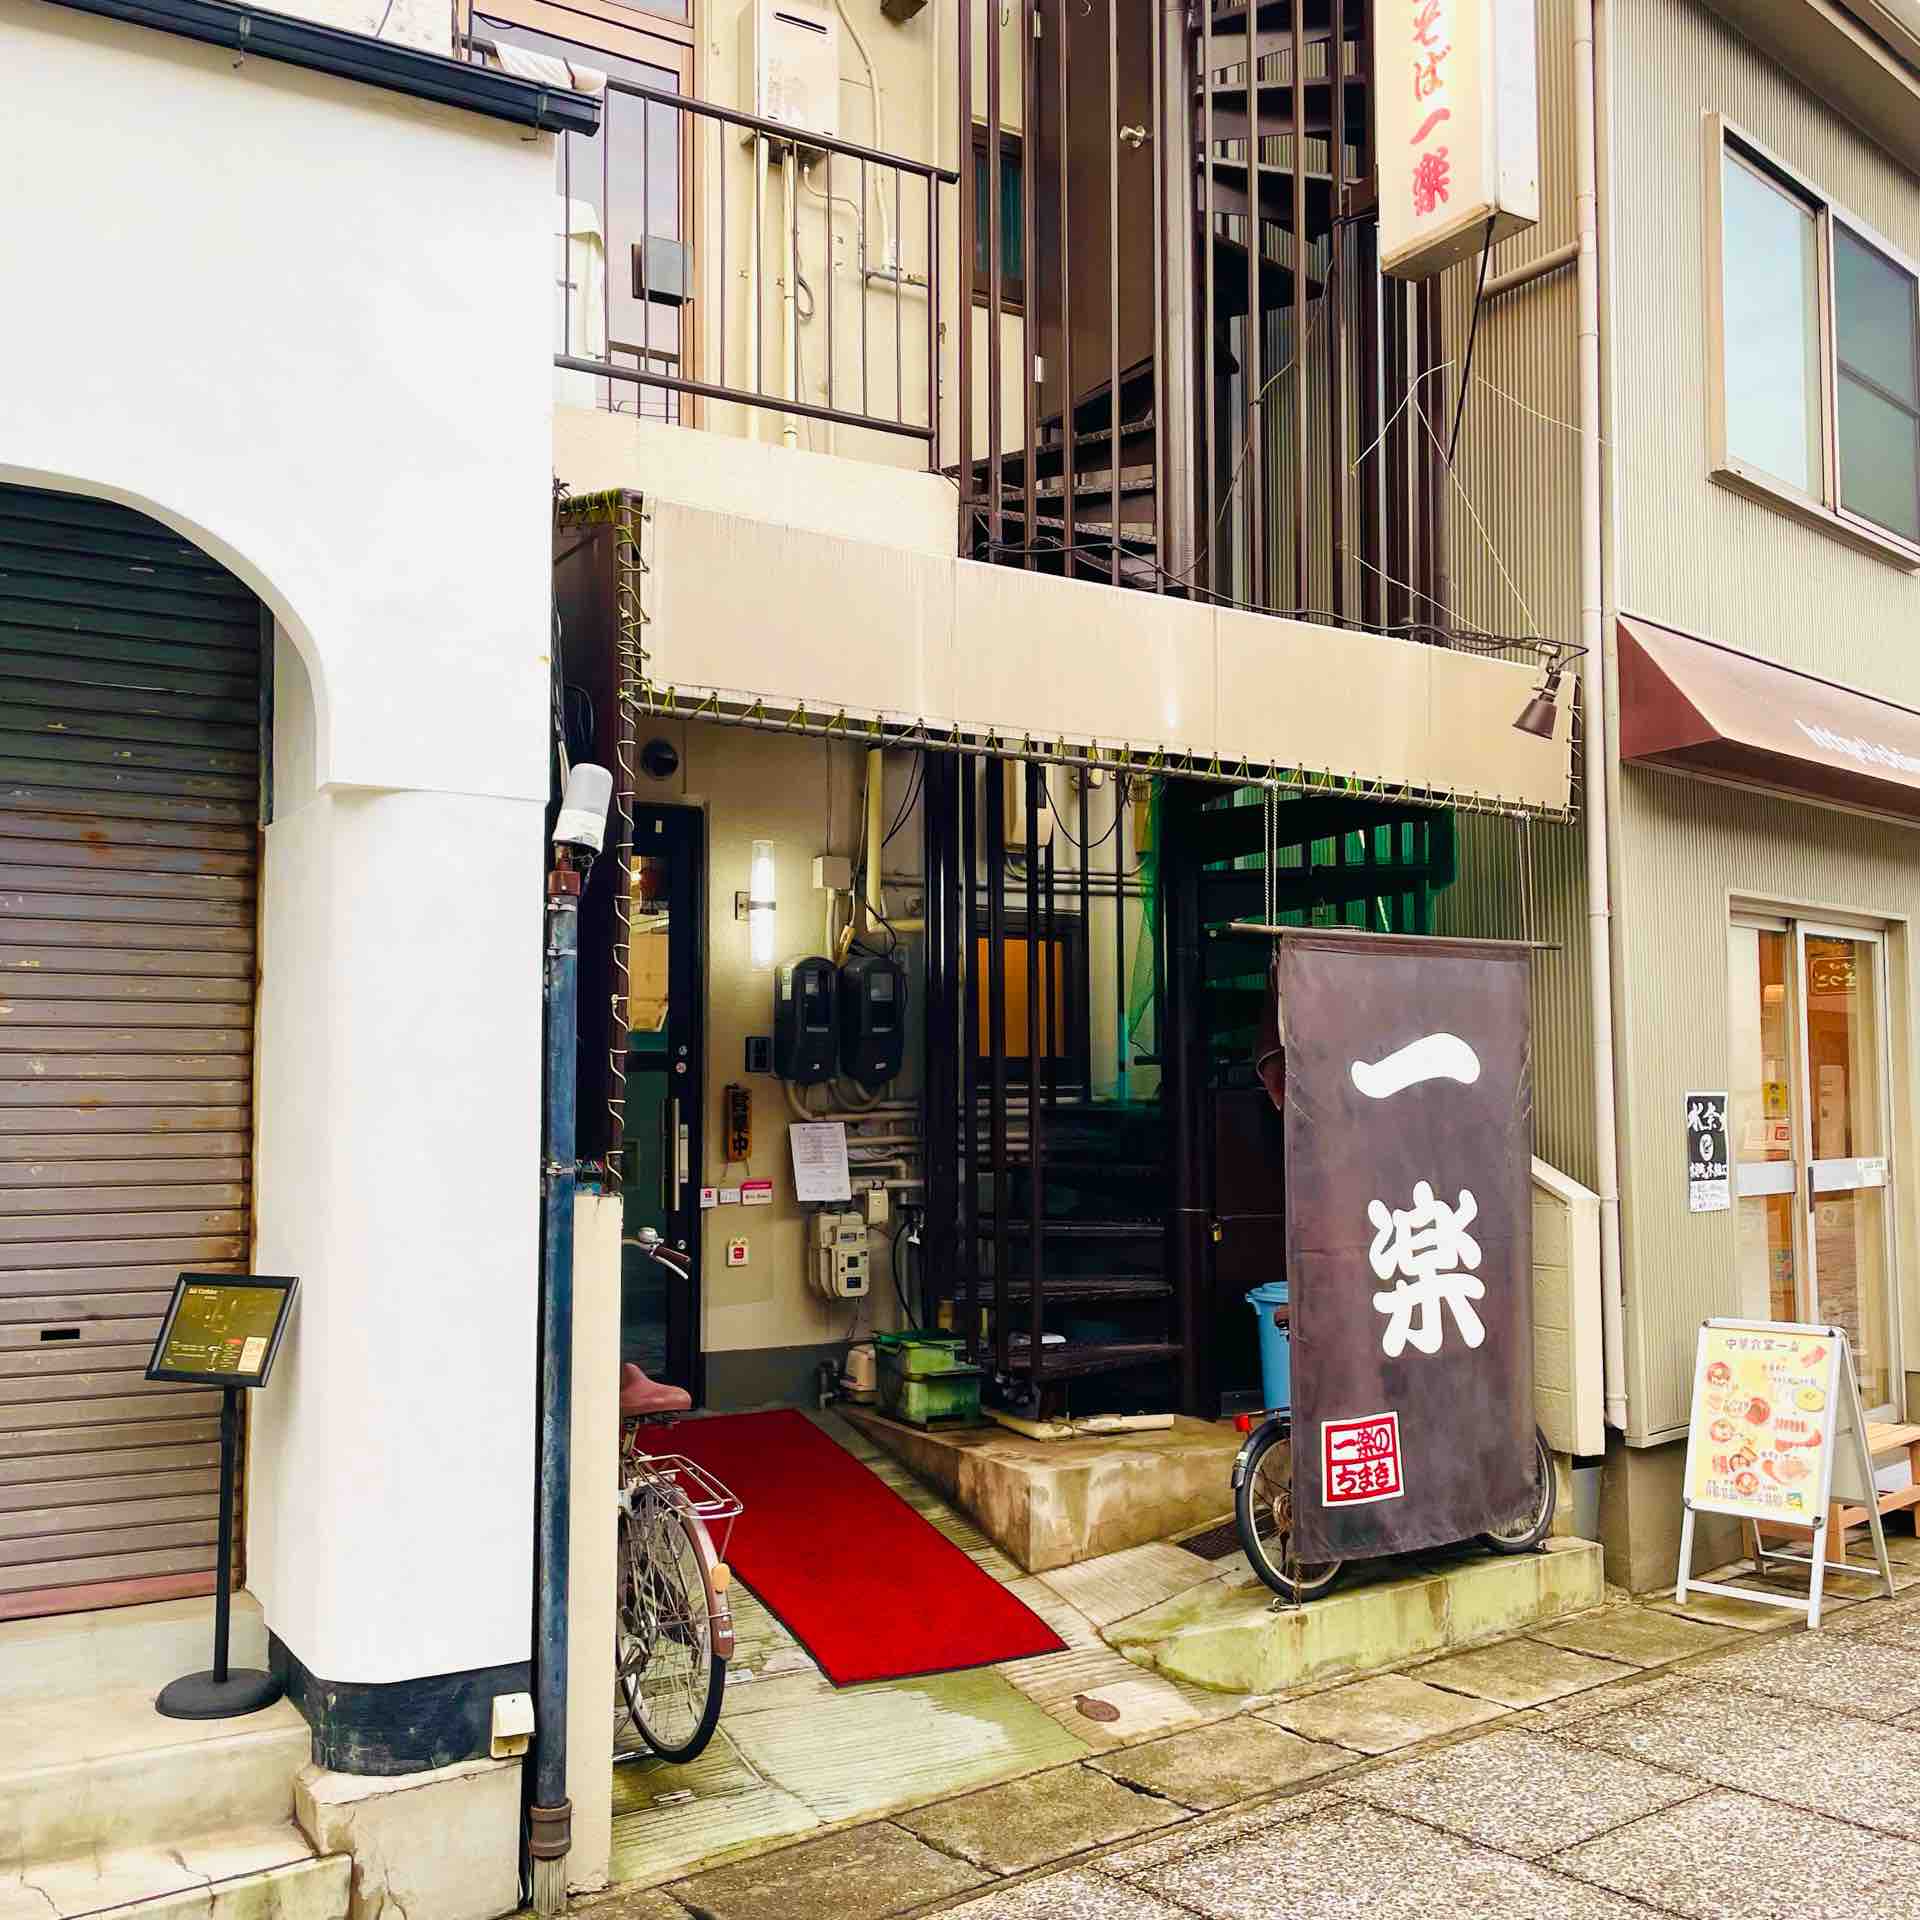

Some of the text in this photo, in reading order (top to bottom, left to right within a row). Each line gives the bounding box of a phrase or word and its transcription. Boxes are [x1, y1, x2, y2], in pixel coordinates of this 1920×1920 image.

[1350, 1031, 1486, 1359] 一楽
[1333, 1426, 1390, 1459] 一楽の
[1335, 1461, 1390, 1493] ちまき
